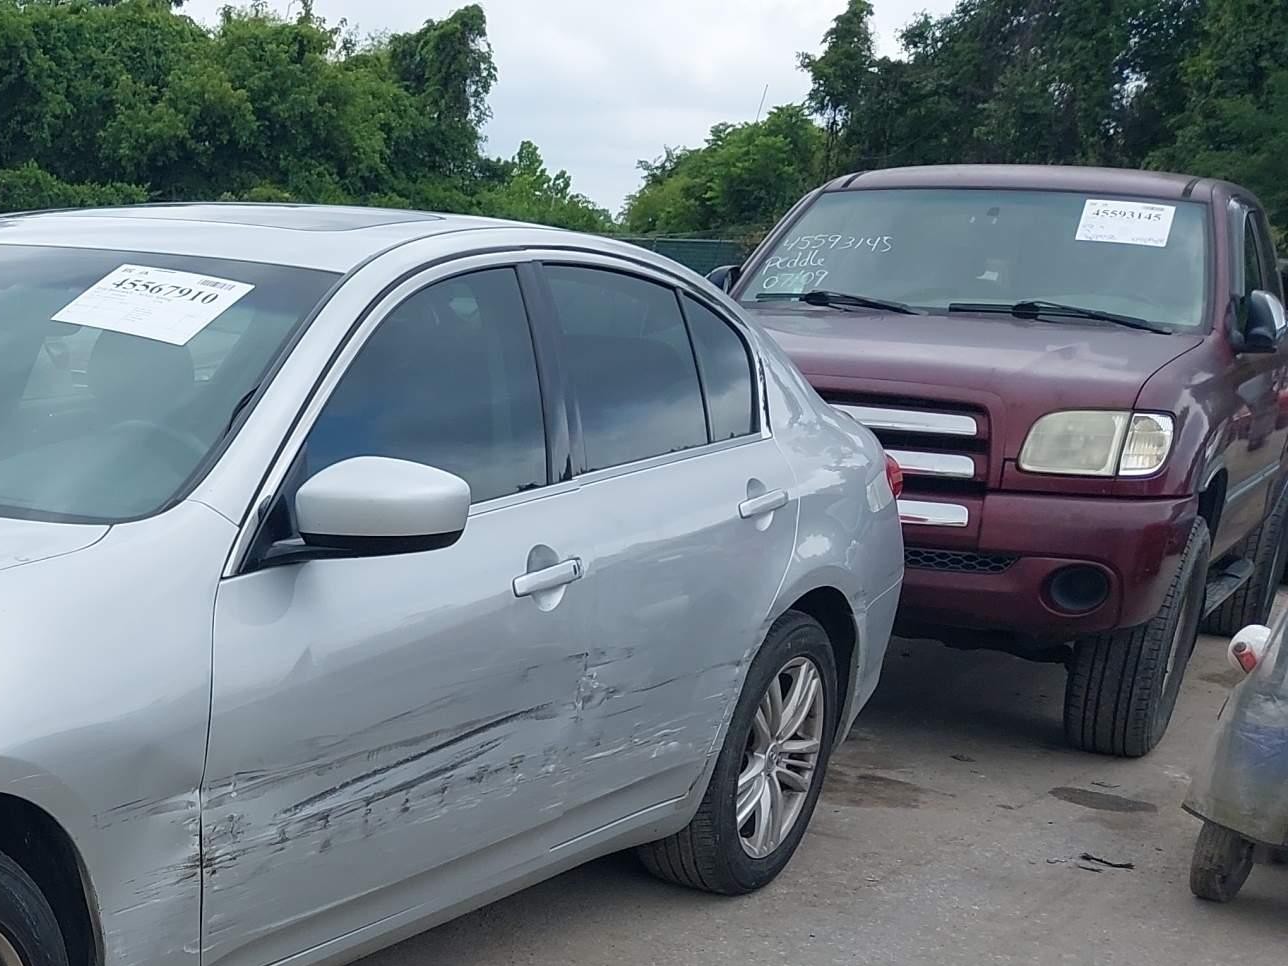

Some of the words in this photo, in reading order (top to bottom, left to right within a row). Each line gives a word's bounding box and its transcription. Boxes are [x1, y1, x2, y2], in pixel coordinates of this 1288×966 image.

[1092, 209, 1162, 221] 45593145
[783, 234, 893, 252] 45593145
[112, 278, 219, 305] 45567910
